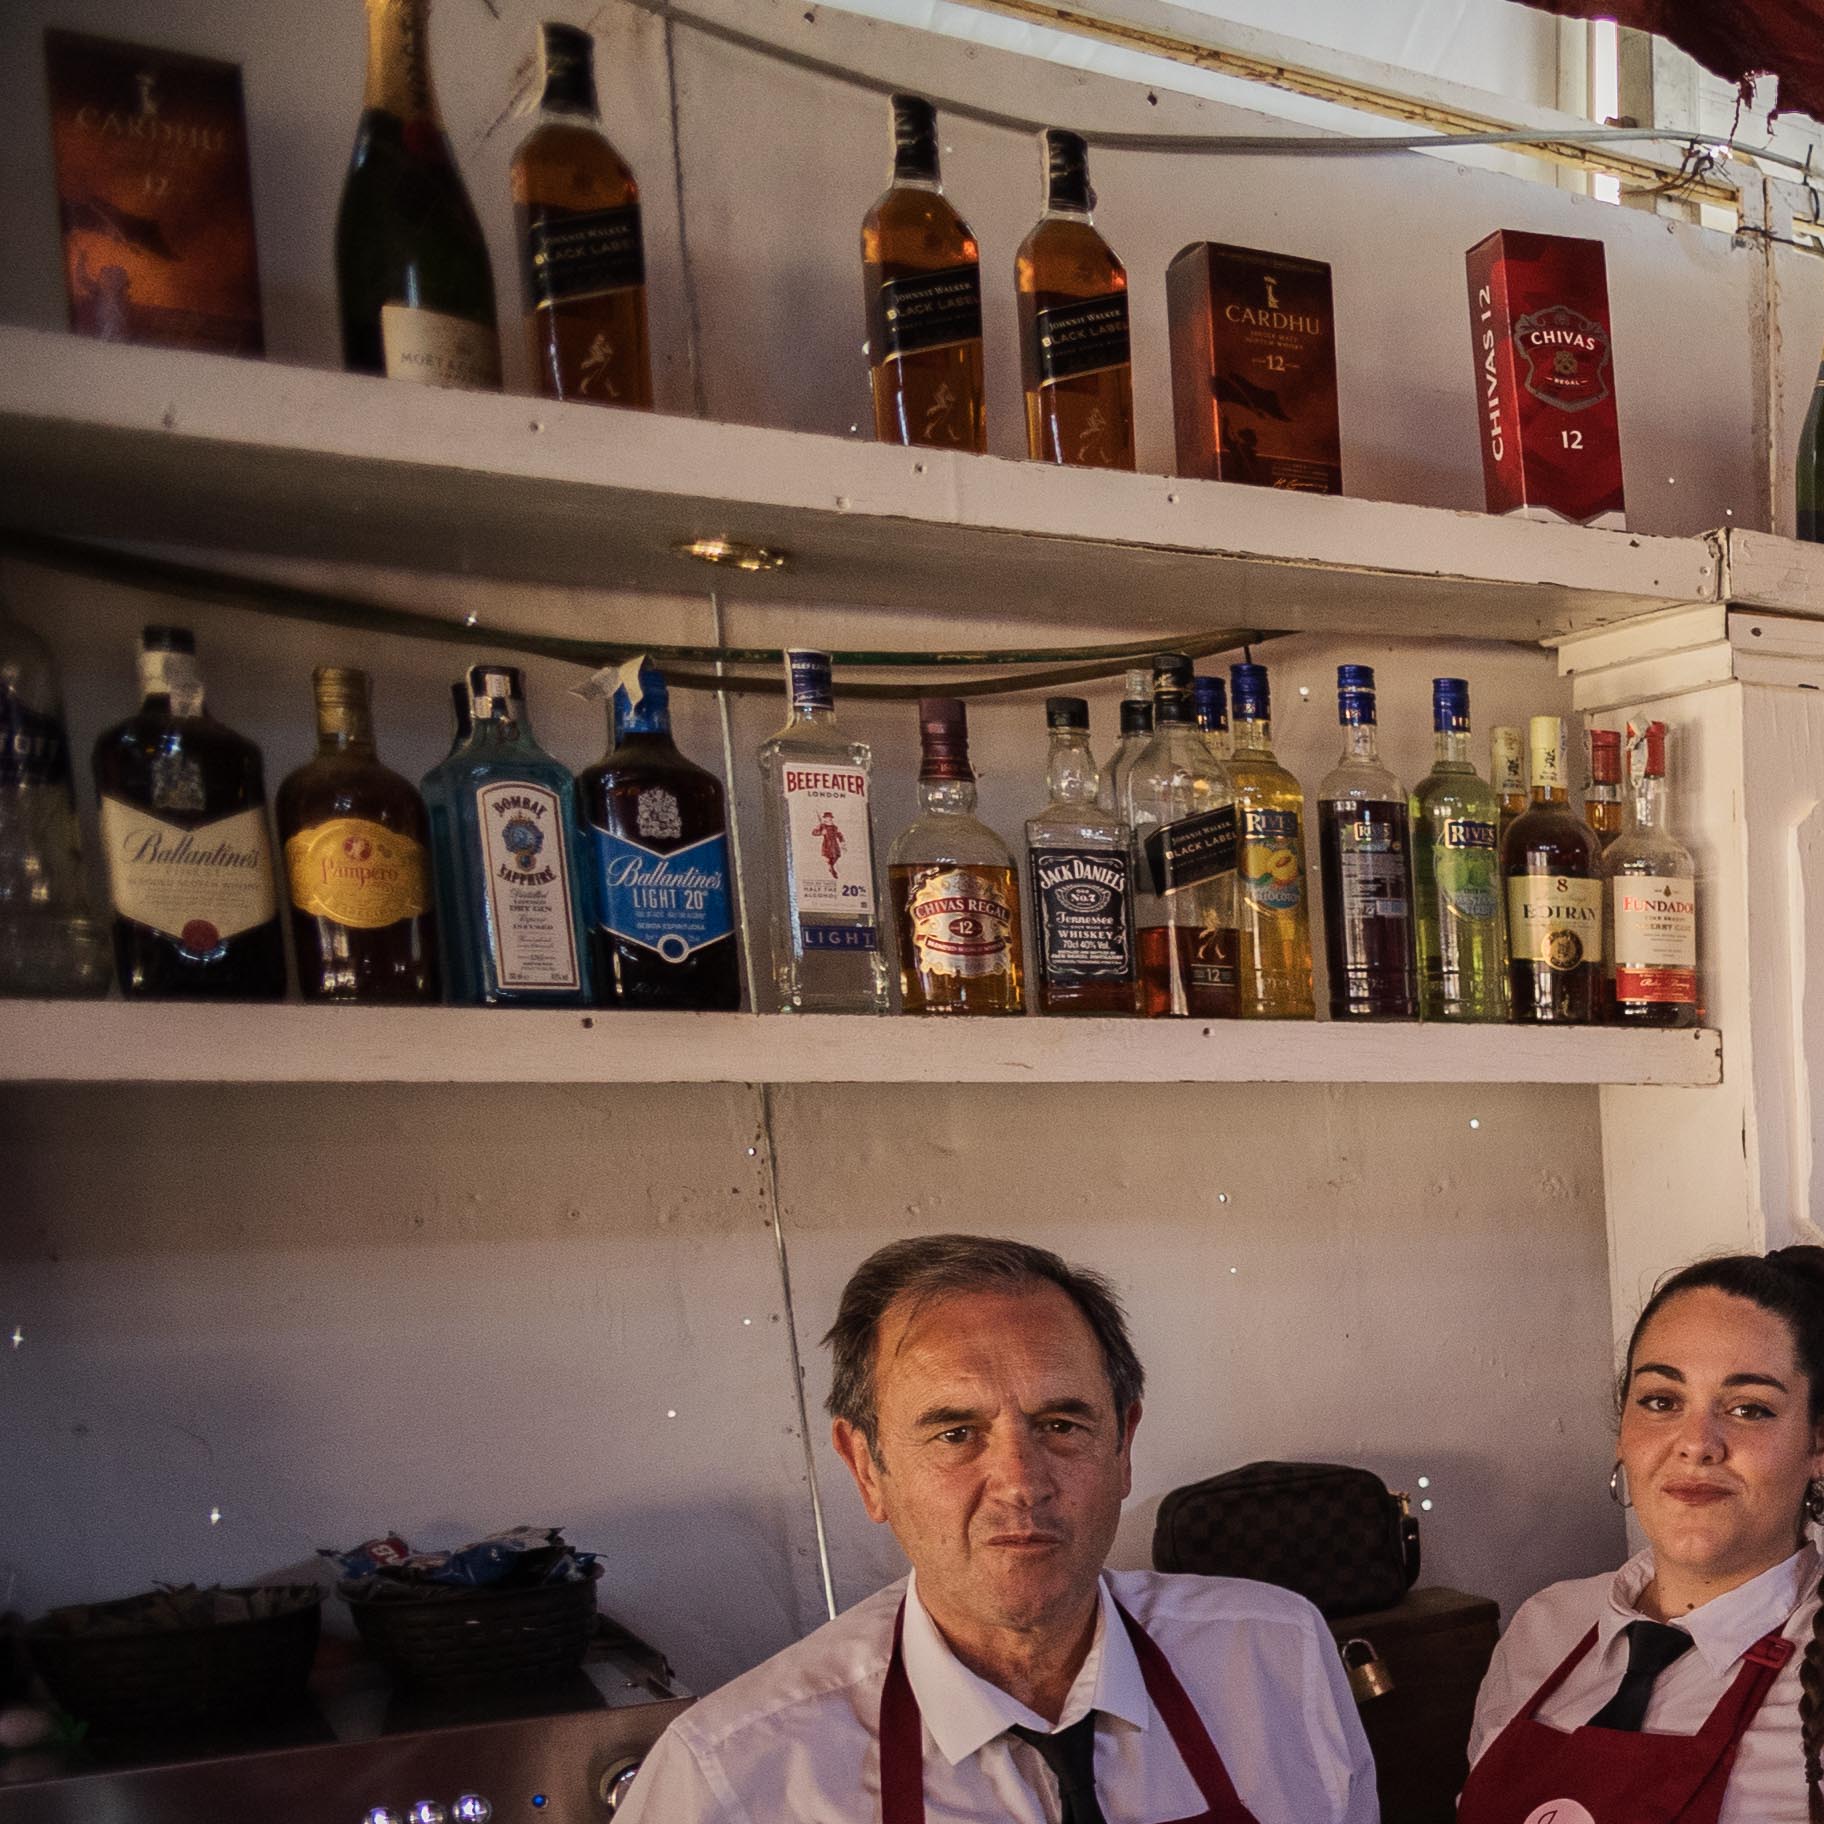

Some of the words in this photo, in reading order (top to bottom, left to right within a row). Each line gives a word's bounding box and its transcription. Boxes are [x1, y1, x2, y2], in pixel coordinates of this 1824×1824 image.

[887, 301, 932, 320] BLACK
[1478, 284, 1492, 321] 12
[1225, 304, 1321, 335] CARDHU
[1042, 331, 1085, 348] BLACK
[1531, 330, 1595, 352] CHIVAS
[1265, 354, 1286, 372] 12
[1482, 329, 1504, 462] CHIVAS
[1561, 429, 1584, 450] 12
[786, 771, 865, 797] BEEFEATER
[807, 791, 847, 799] LONDON
[491, 795, 548, 819] BOMBAY
[1246, 812, 1297, 833] RIVES
[1451, 824, 1495, 843] RIVES
[122, 828, 260, 869] Ballantine's
[1165, 842, 1203, 860] BLACK
[1204, 830, 1238, 847] LABEL
[320, 857, 399, 889] Pampero
[496, 863, 557, 886] SAPPHIRE
[606, 854, 723, 890] Ballantine's
[1038, 863, 1073, 889] JACK
[1073, 859, 1126, 892] DANIEL'S
[1556, 877, 1569, 893] 8
[632, 887, 677, 909] LIGHT
[915, 899, 965, 918] CHIVAS
[967, 899, 1009, 920] REGAL
[1055, 911, 1114, 925] Tennessee
[805, 930, 875, 945] LIGHT
[959, 920, 974, 934] 12
[1058, 930, 1114, 940] WHISKEY
[1206, 968, 1221, 982] 12
